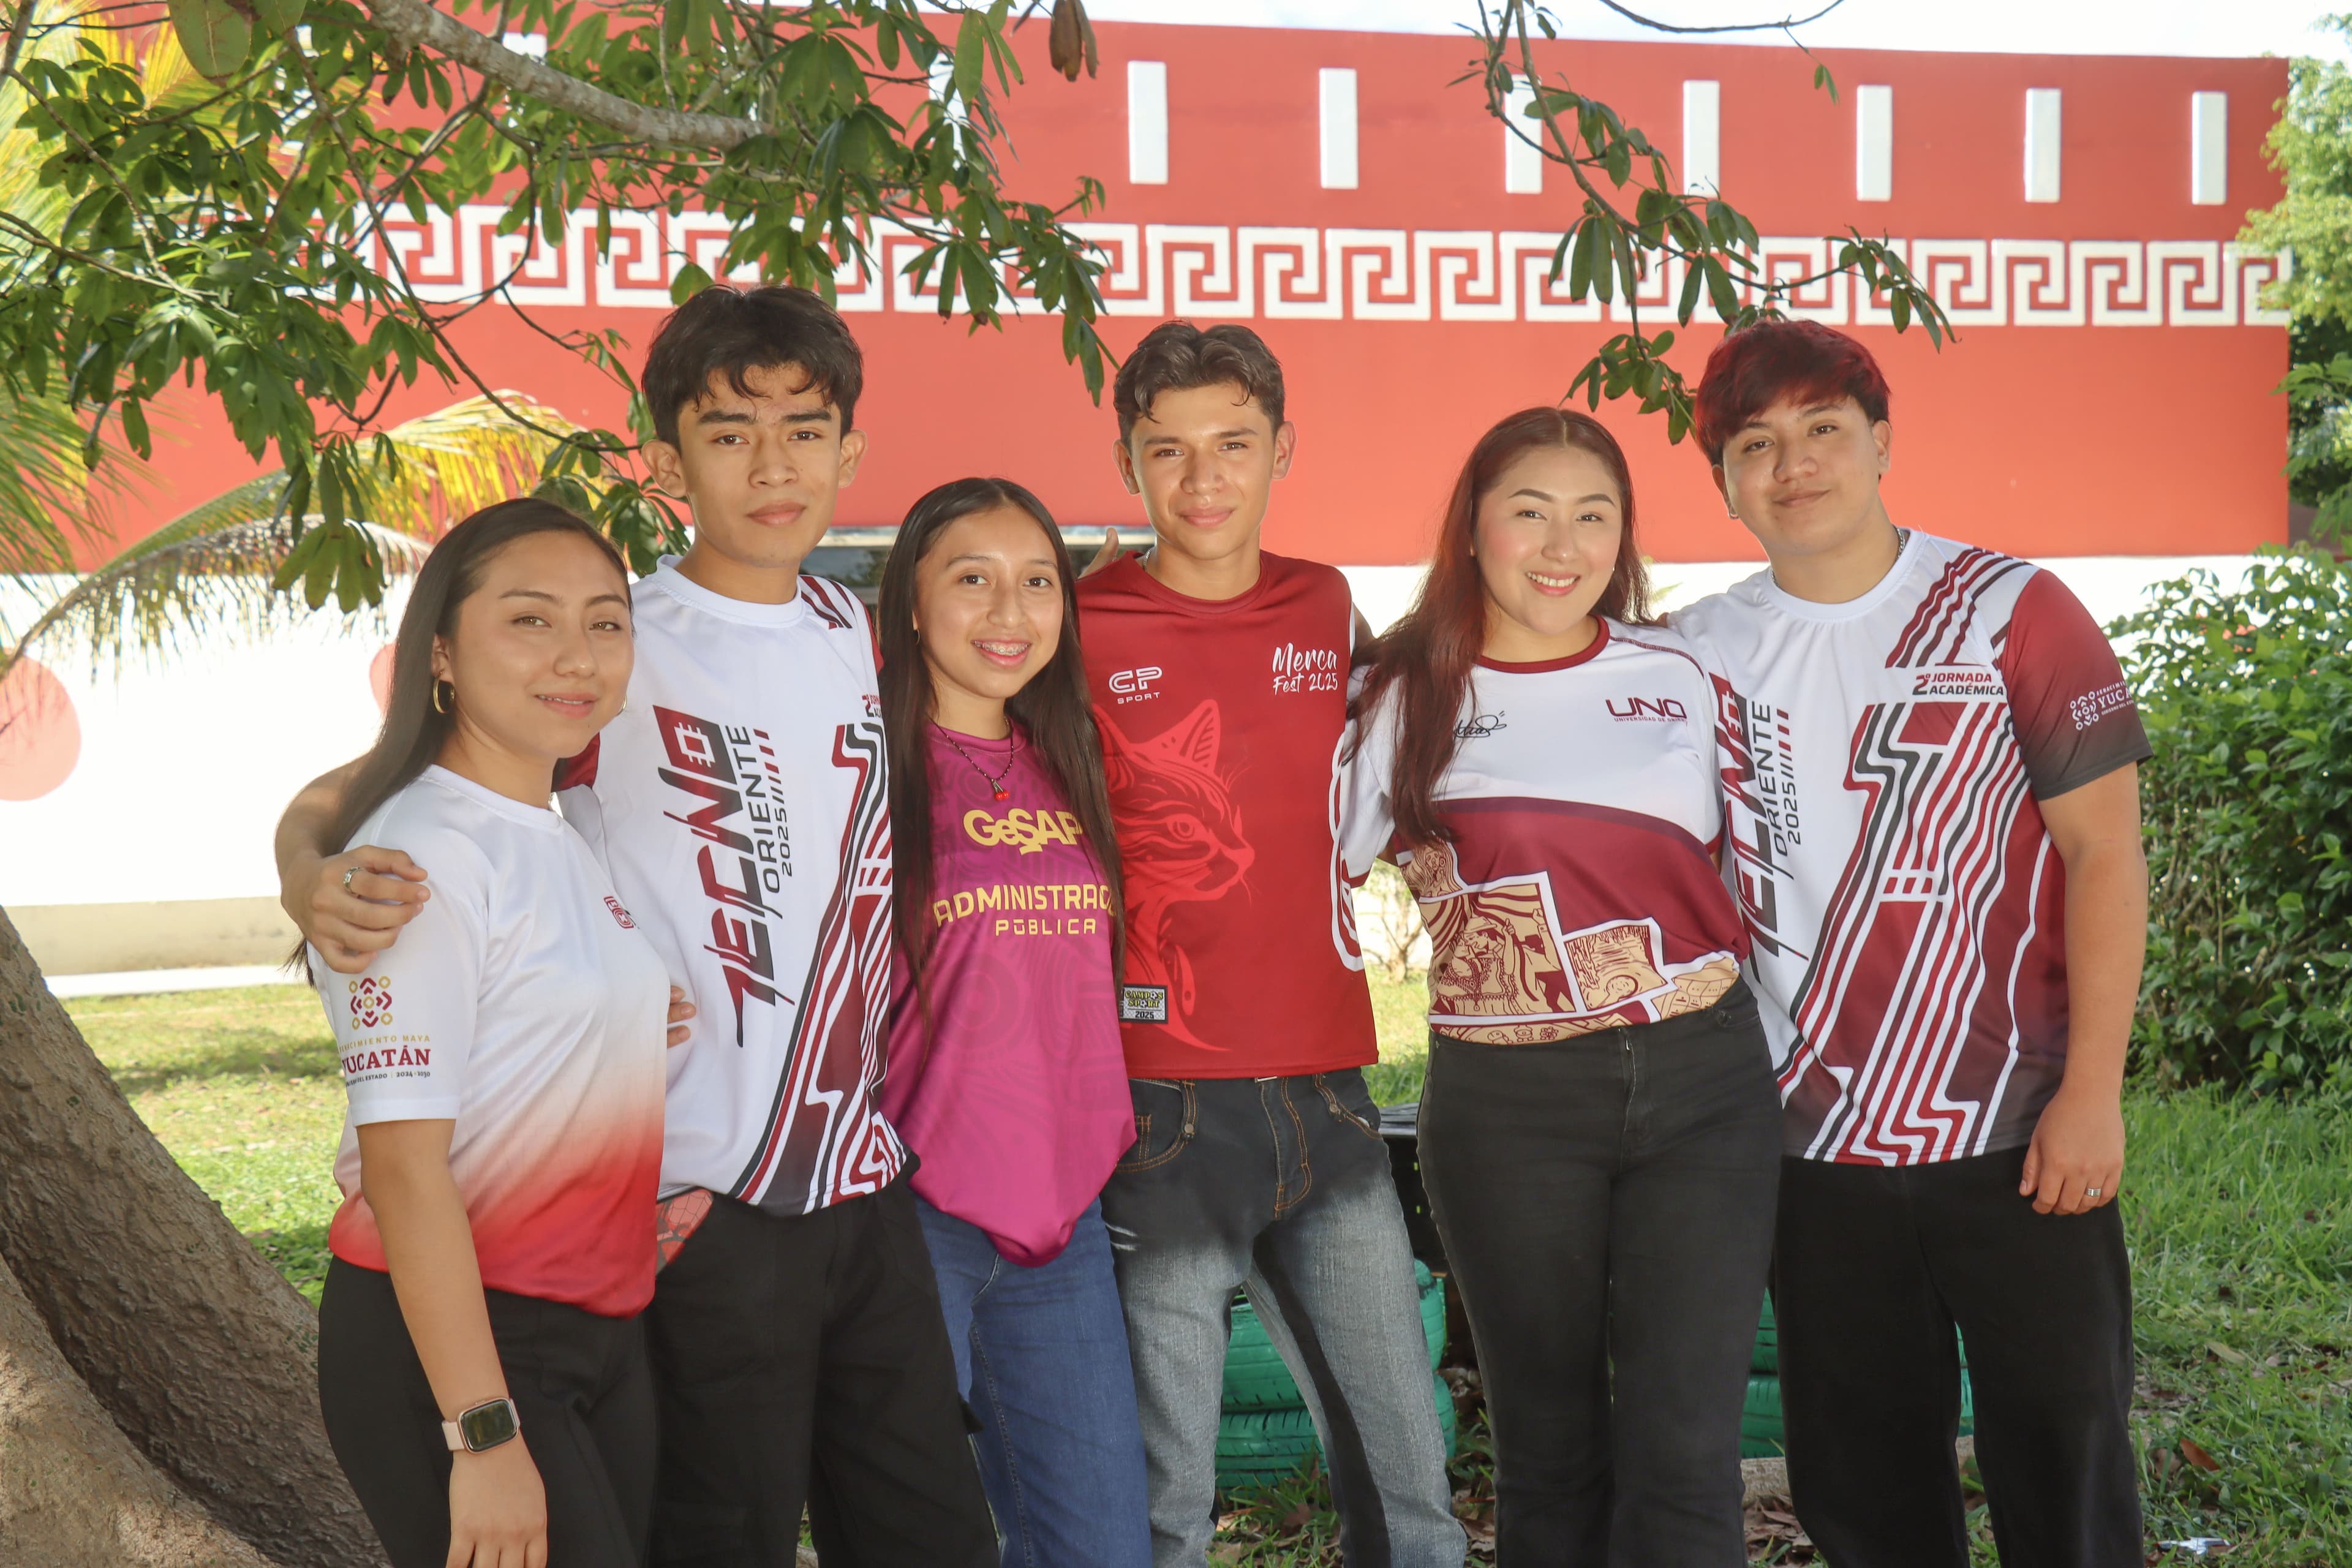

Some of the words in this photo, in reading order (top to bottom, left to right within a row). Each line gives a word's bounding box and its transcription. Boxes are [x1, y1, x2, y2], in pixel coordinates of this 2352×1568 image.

[1272, 642, 1337, 677] Merca
[1273, 672, 1305, 696] Fest
[1308, 672, 1338, 692] 2025
[1929, 682, 2004, 695] ACADÉMICA
[1931, 673, 1992, 682] JORNADA
[1117, 692, 1160, 704] SPORT
[1605, 697, 1687, 719] UNO
[1752, 700, 1788, 858] ORIENTE
[725, 725, 780, 894] ORIENTE
[1782, 782, 1801, 846] 2025
[774, 807, 793, 878] 2025
[1135, 1011, 1155, 1019] 2025
[342, 1045, 431, 1074] YUCATÁN
